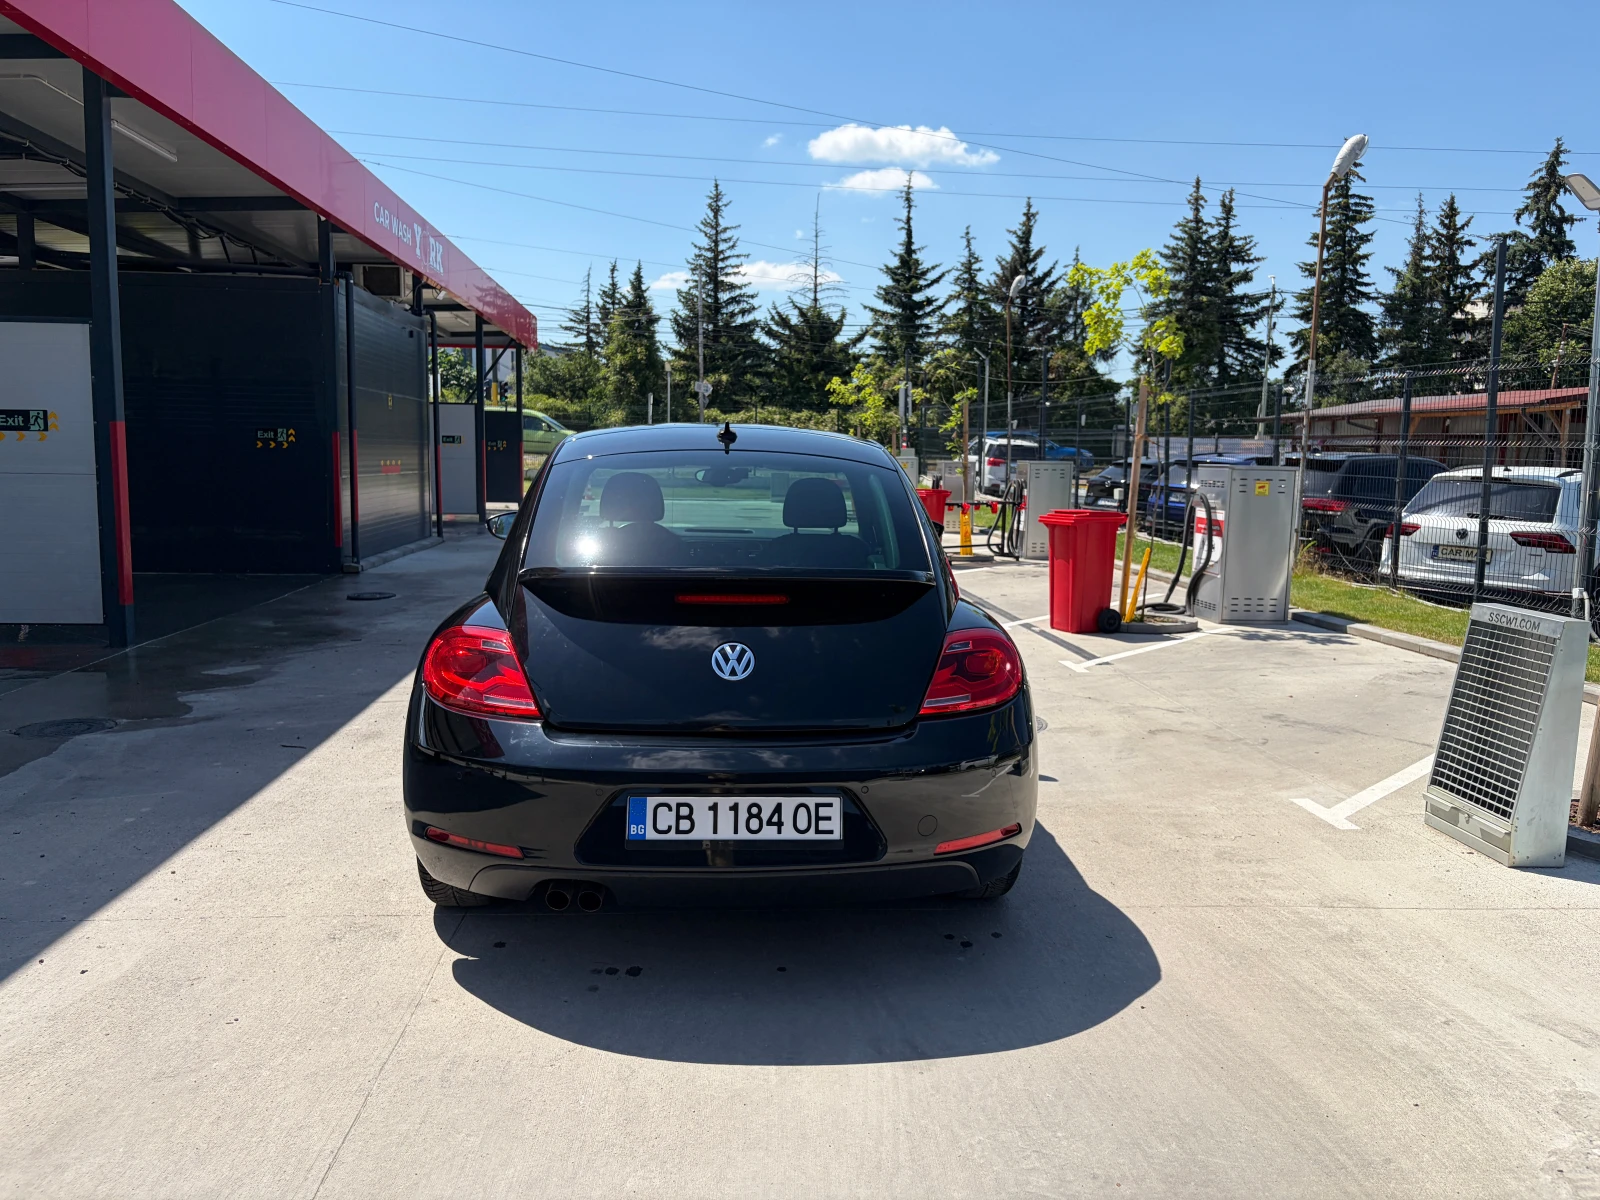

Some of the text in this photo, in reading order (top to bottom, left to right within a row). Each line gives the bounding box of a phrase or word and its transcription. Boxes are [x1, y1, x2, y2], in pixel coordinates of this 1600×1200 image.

[374, 202, 390, 230] CAR
[391, 215, 412, 247] WASH
[0, 414, 24, 426] Exit
[257, 430, 274, 438] Exit
[1441, 547, 1462, 556] CAR
[1488, 612, 1541, 633] SSCW1.COM
[652, 802, 695, 835] CB
[708, 802, 784, 835] 1184
[630, 824, 645, 835] BG
